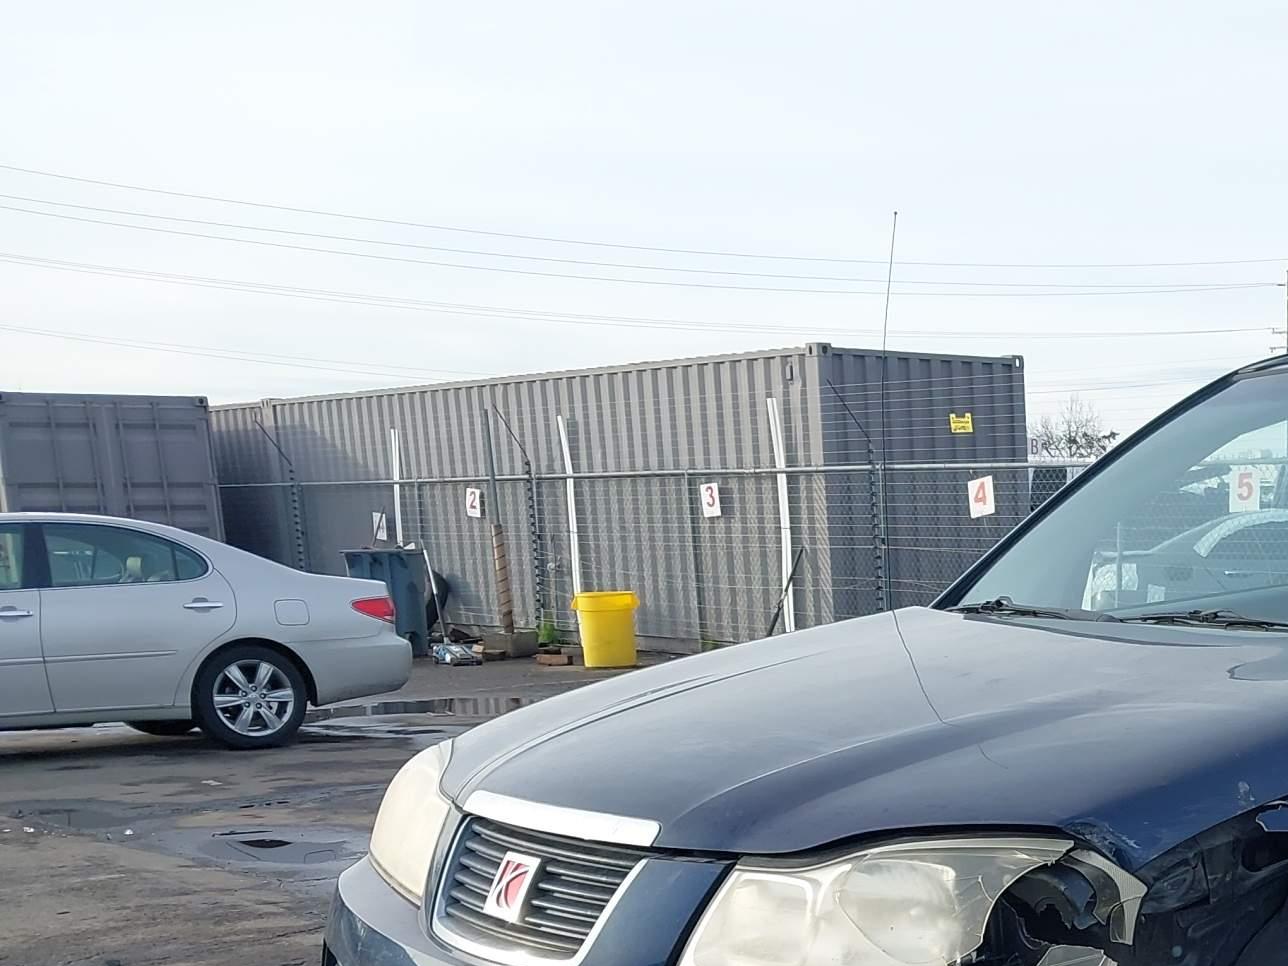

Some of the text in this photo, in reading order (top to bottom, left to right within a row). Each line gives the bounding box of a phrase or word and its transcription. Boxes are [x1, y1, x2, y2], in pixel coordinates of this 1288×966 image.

[705, 485, 716, 508] 3
[973, 481, 987, 506] 4
[1237, 472, 1253, 501] 5
[469, 490, 478, 510] 2
